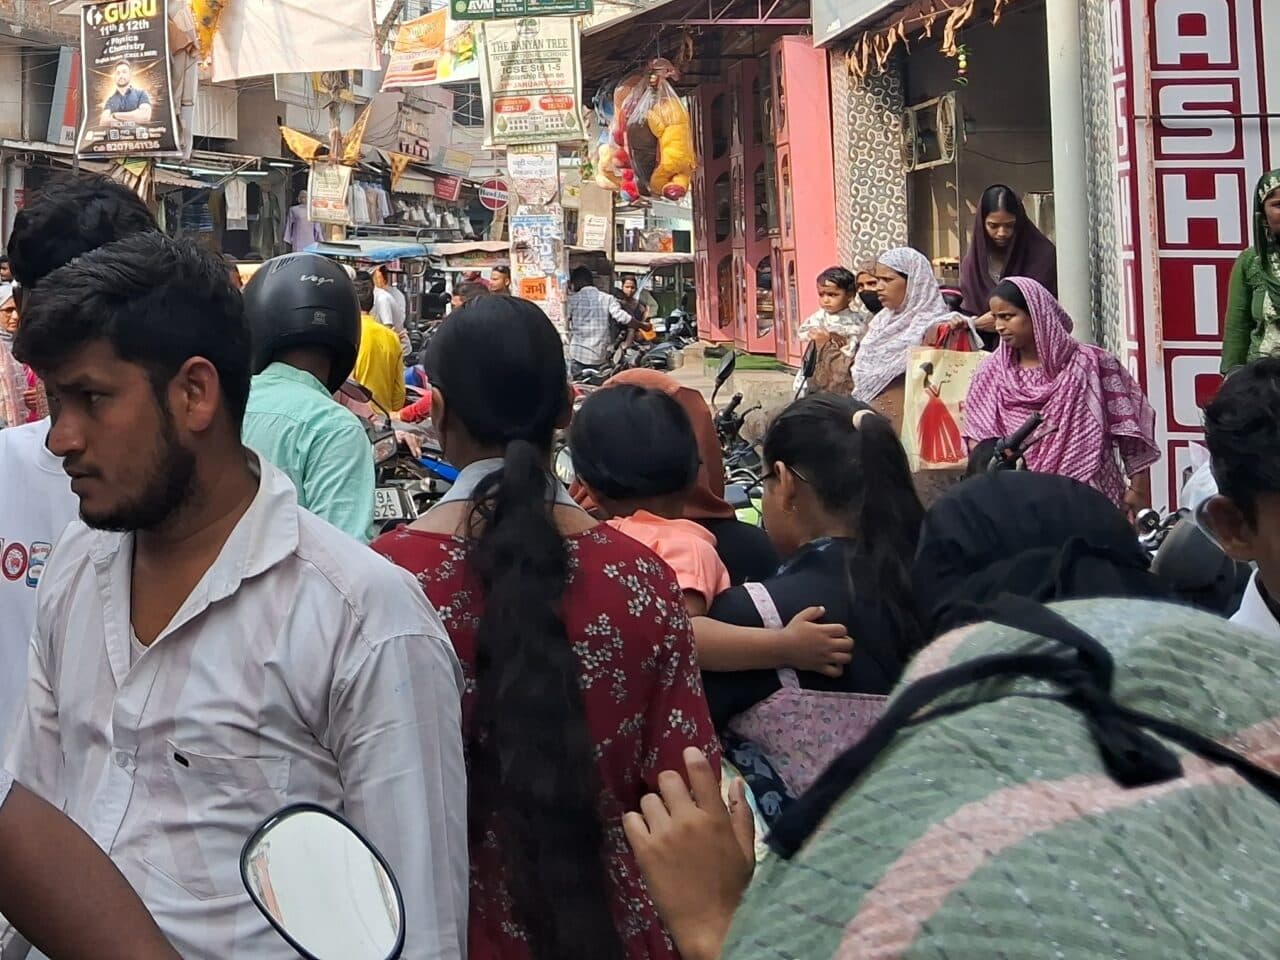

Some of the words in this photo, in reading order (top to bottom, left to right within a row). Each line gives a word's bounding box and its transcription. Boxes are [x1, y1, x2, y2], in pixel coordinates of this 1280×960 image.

[468, 0, 494, 11] AVM
[99, 24, 117, 36] 11th
[126, 18, 150, 31] 12th
[108, 42, 145, 54] Chemistry
[491, 41, 510, 53] THE
[511, 39, 544, 51] BANYAN
[545, 38, 568, 49] TREE
[502, 65, 528, 74] ICSE
[547, 63, 561, 71] 1-5
